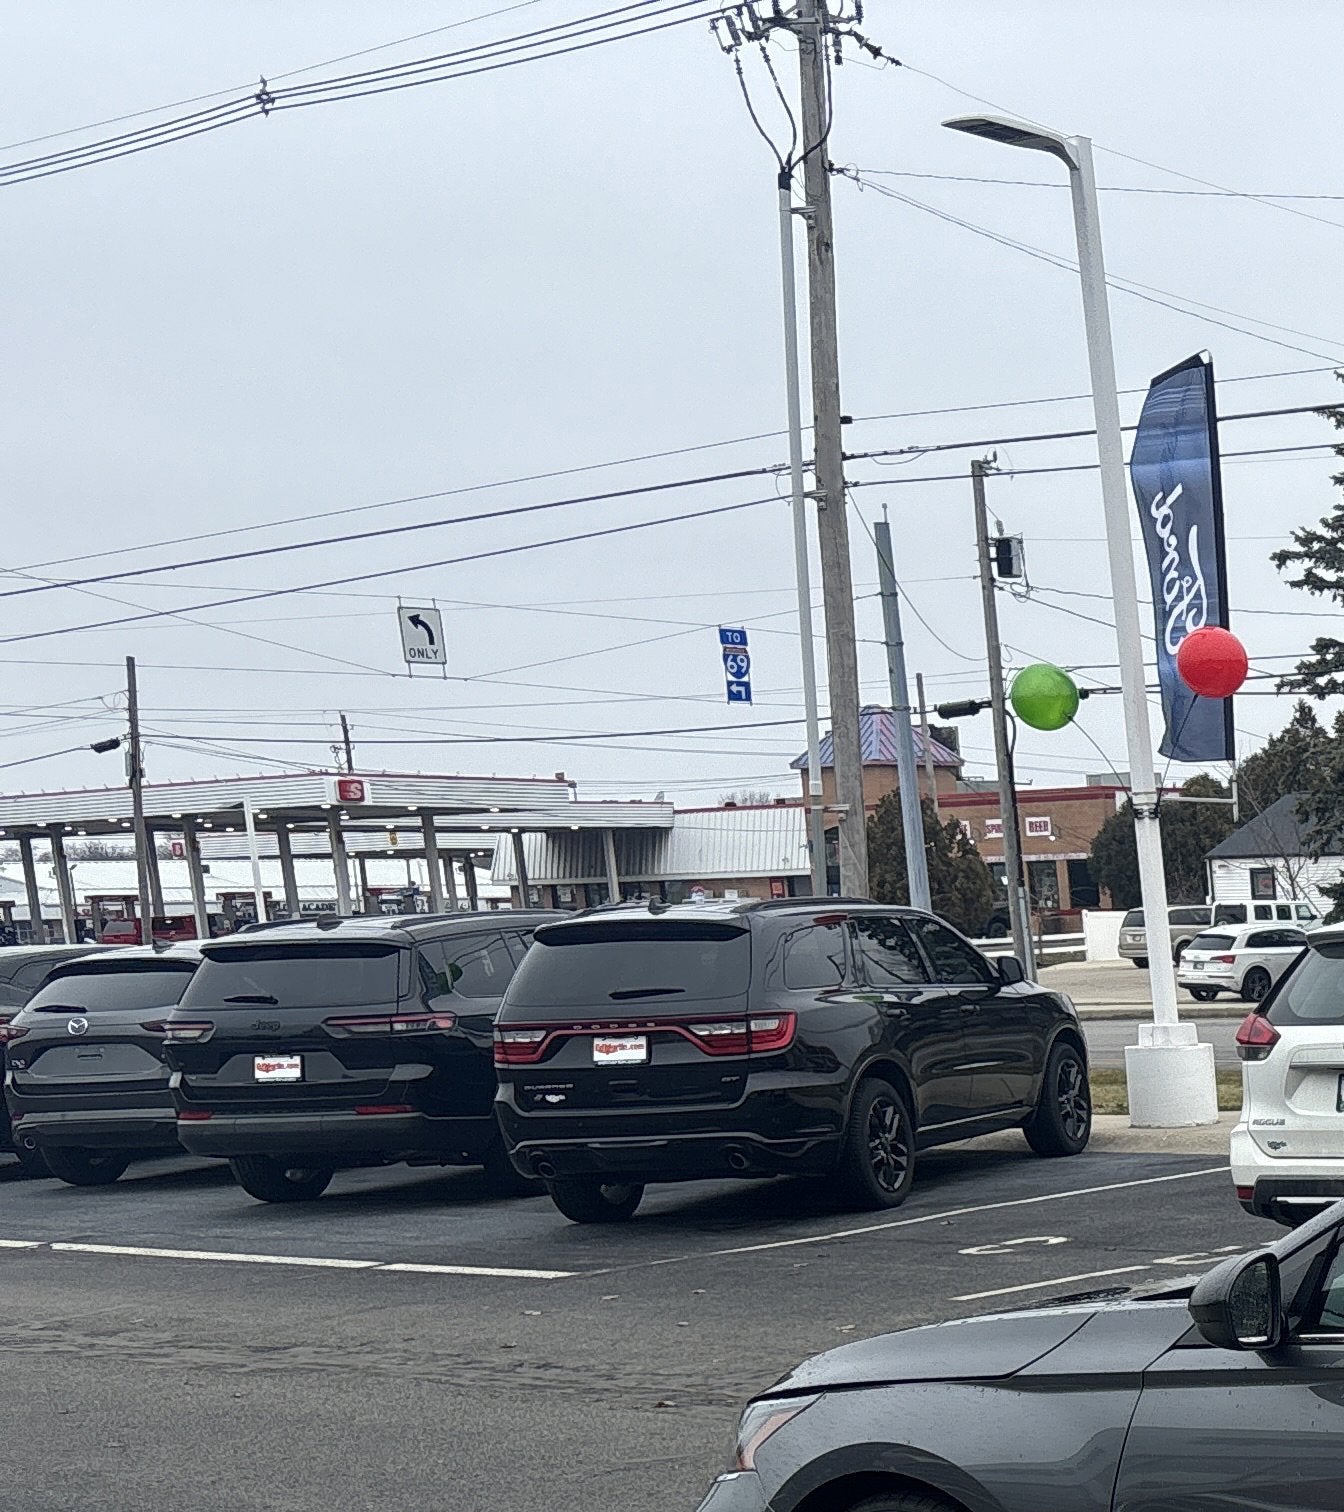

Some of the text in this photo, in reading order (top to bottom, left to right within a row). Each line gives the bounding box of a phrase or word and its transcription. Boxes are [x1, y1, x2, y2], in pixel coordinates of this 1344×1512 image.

[725, 631, 741, 643] TO
[408, 647, 439, 659] ONLY
[726, 654, 748, 674] 69
